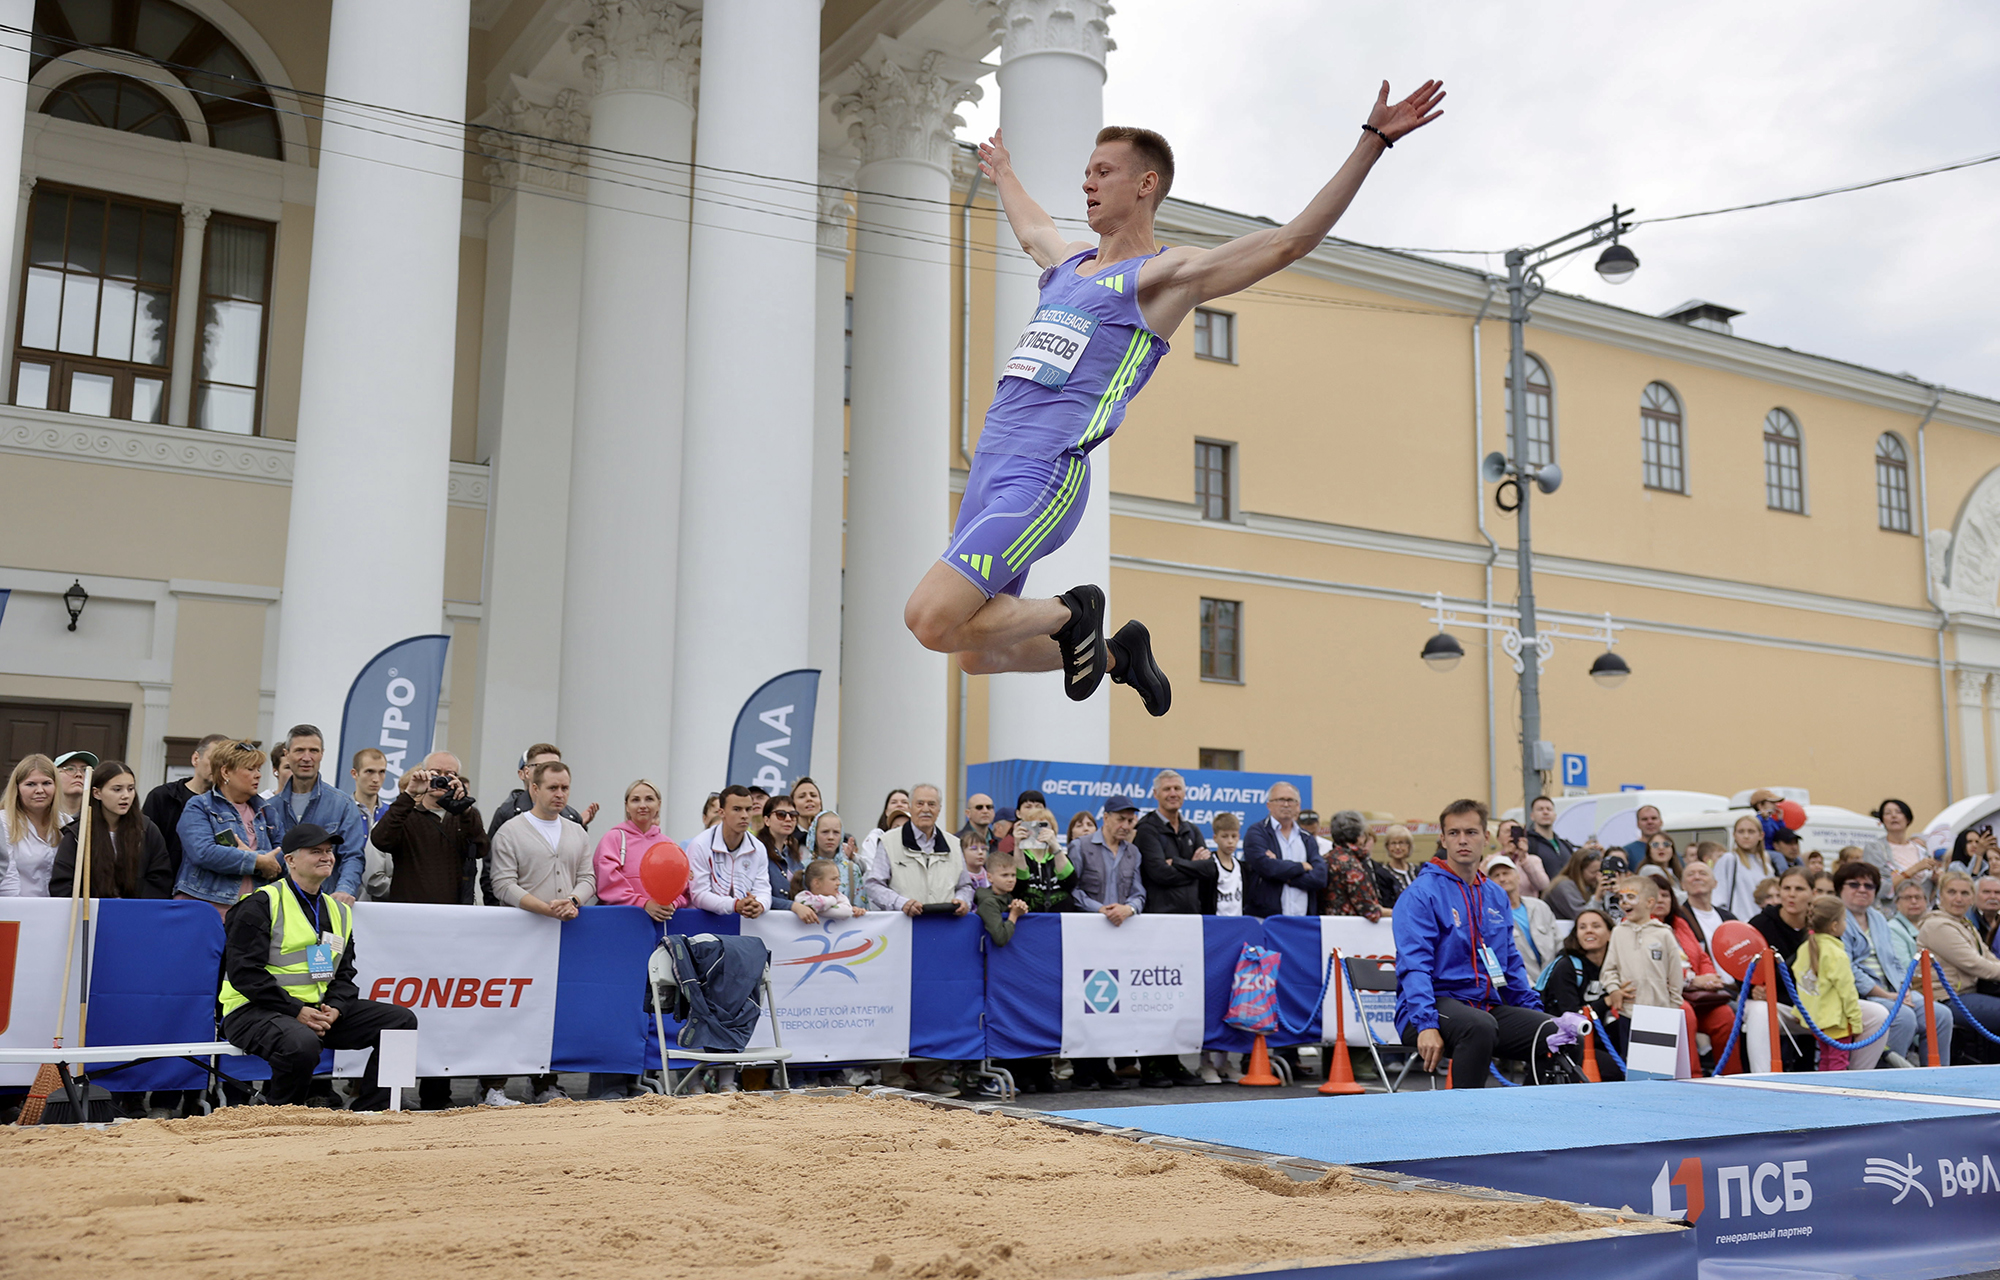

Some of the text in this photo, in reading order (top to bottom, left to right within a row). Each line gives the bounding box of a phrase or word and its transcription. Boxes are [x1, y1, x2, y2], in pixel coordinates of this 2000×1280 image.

[1061, 312, 1091, 332] LEAGUE
[379, 677, 416, 804] САГРО
[1566, 756, 1583, 784] P
[1041, 779, 1146, 799] ФЕСТИВАЛЬ
[1130, 966, 1183, 986] zetta
[368, 977, 533, 1009] FONBET
[1130, 992, 1185, 1001] GROUP
[813, 1005, 848, 1016] ЛЕГКОЙ
[850, 1005, 895, 1015] АТЛЕТИКИ
[1130, 1004, 1175, 1012] СПОНСОР
[780, 1018, 875, 1030] ТВЕРСКОЙ ОБЛАСТИ
[1717, 1160, 1813, 1220] ПСБ
[1715, 1225, 1813, 1245] генеральный партнер
